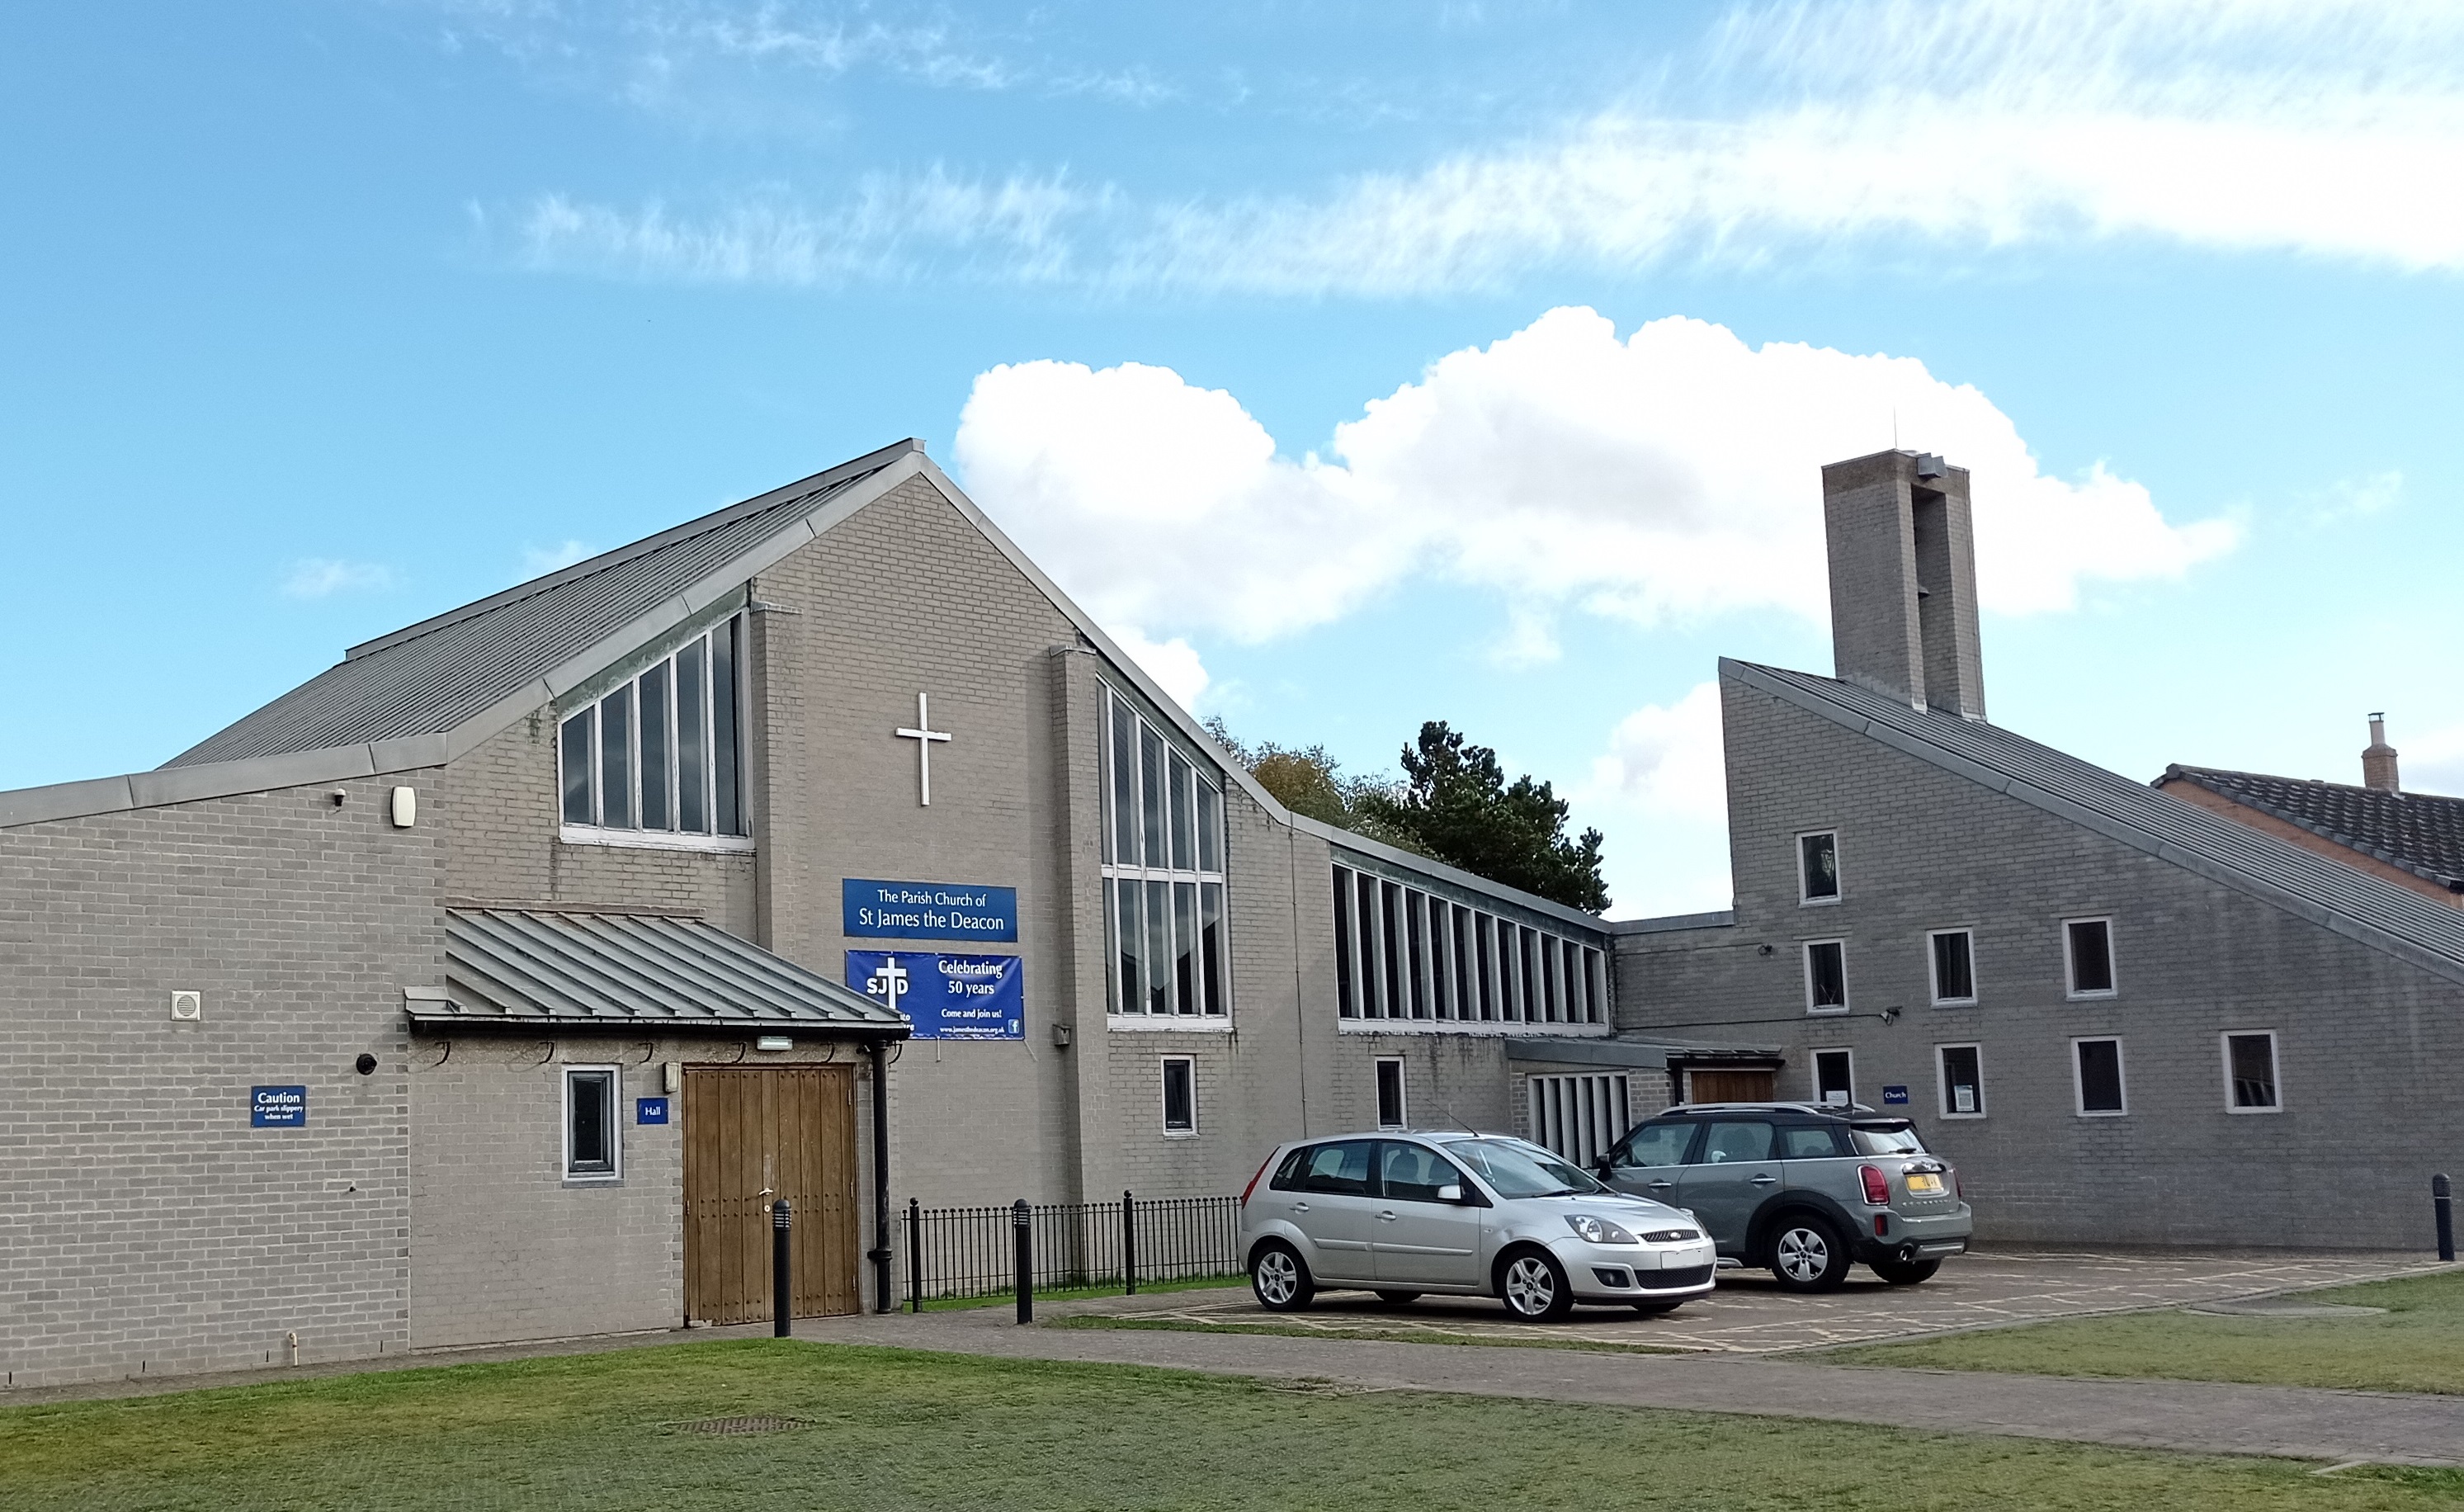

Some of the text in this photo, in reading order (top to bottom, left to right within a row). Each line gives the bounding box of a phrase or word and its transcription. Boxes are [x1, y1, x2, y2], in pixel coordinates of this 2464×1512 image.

[877, 889, 987, 907] The Parish Church of
[859, 908, 1004, 930] St James the Deacon
[938, 960, 1003, 979] Celebrating
[947, 980, 995, 999] 50 years
[941, 1009, 1003, 1020] Come and join us!
[257, 1092, 300, 1103] Caution
[266, 1105, 280, 1113] park
[644, 1106, 661, 1116] Hall
